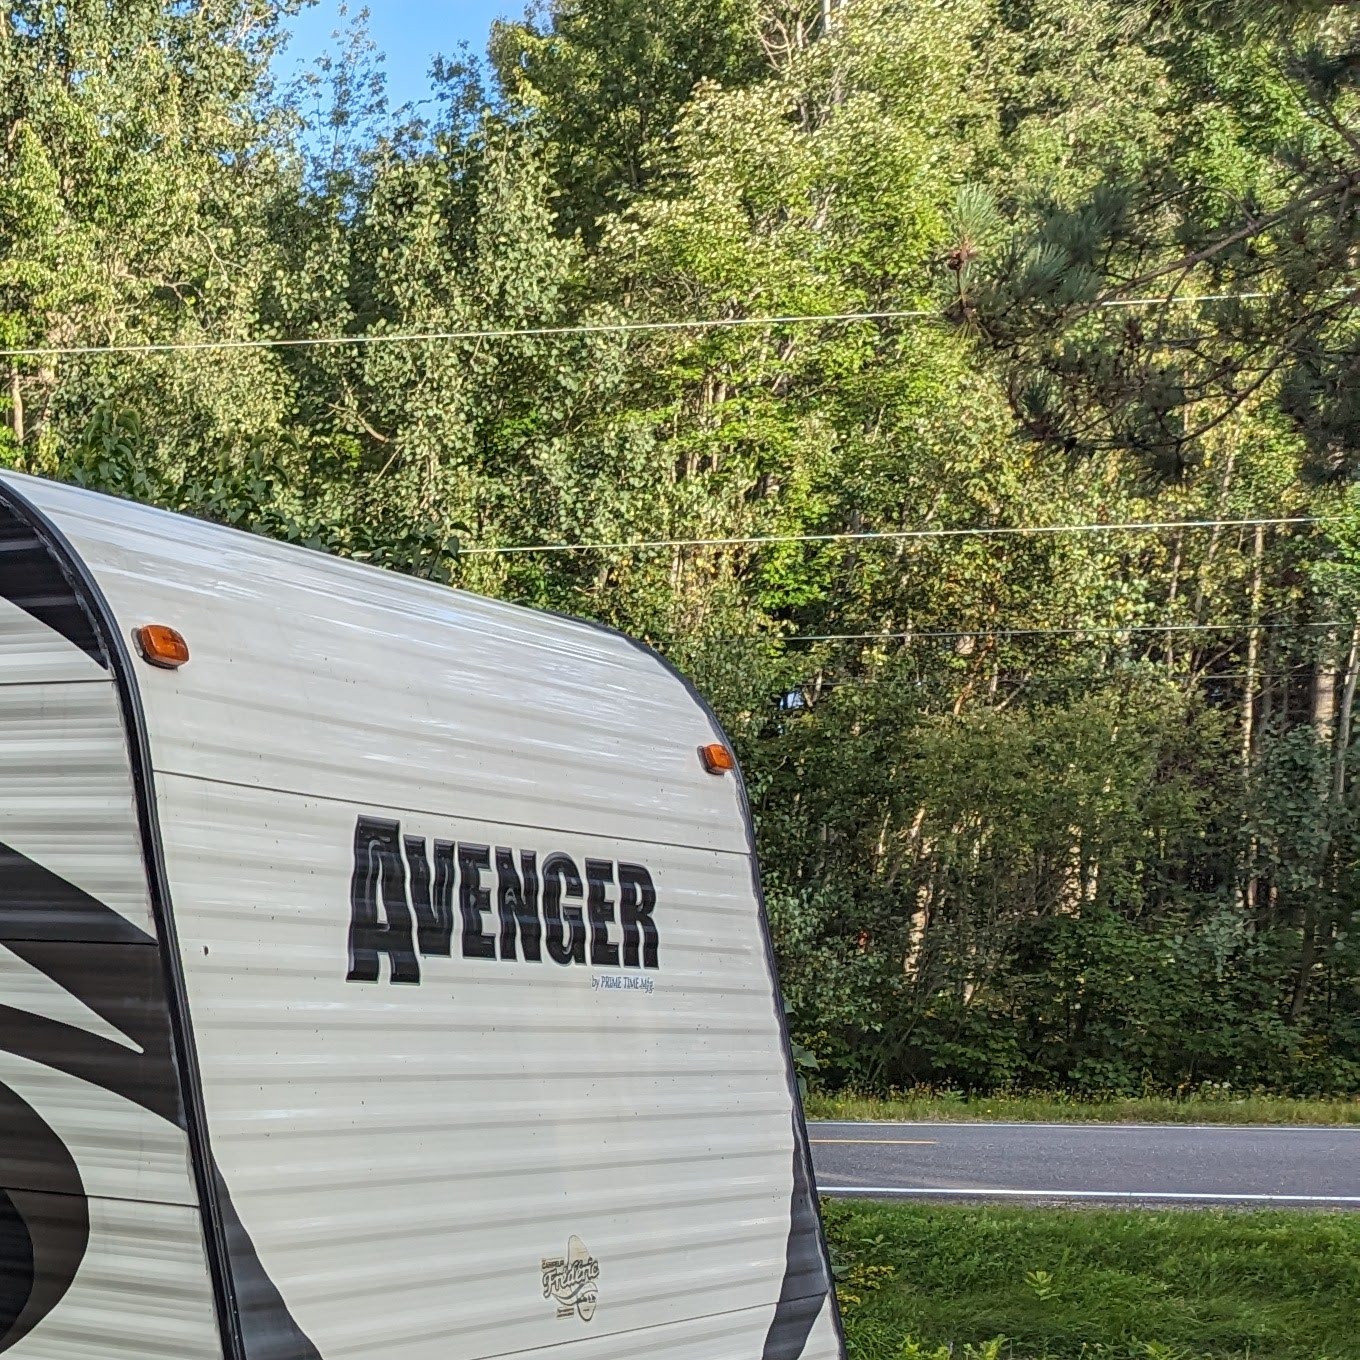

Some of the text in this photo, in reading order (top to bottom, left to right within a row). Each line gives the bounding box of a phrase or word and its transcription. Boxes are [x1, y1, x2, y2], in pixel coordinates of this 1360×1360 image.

[346, 814, 659, 985] AVENGER
[591, 974, 600, 992] by
[601, 975, 622, 989] PRIME
[623, 976, 639, 990] TIME
